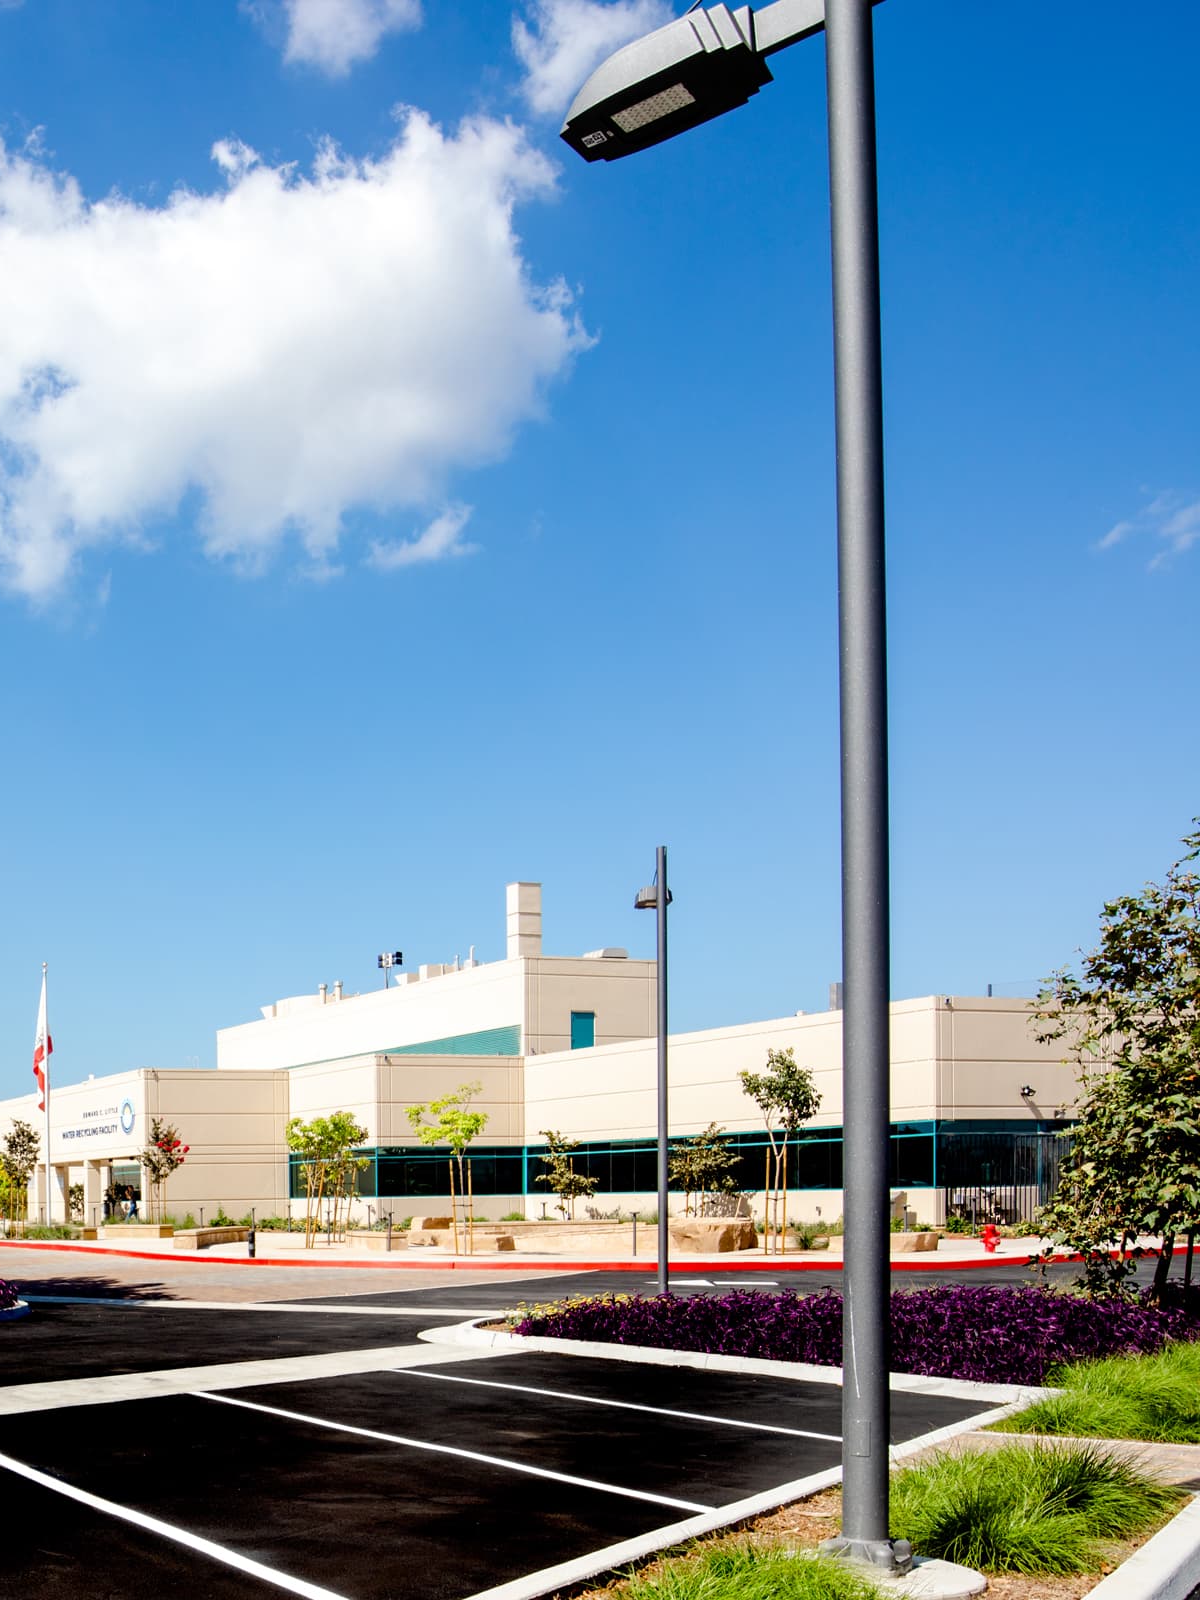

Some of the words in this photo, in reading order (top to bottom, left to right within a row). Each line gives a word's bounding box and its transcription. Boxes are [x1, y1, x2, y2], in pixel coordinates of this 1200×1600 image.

[62, 1130, 75, 1139] WATER
[76, 1127, 98, 1138] RECYCLING
[99, 1124, 118, 1134] FACILITY
